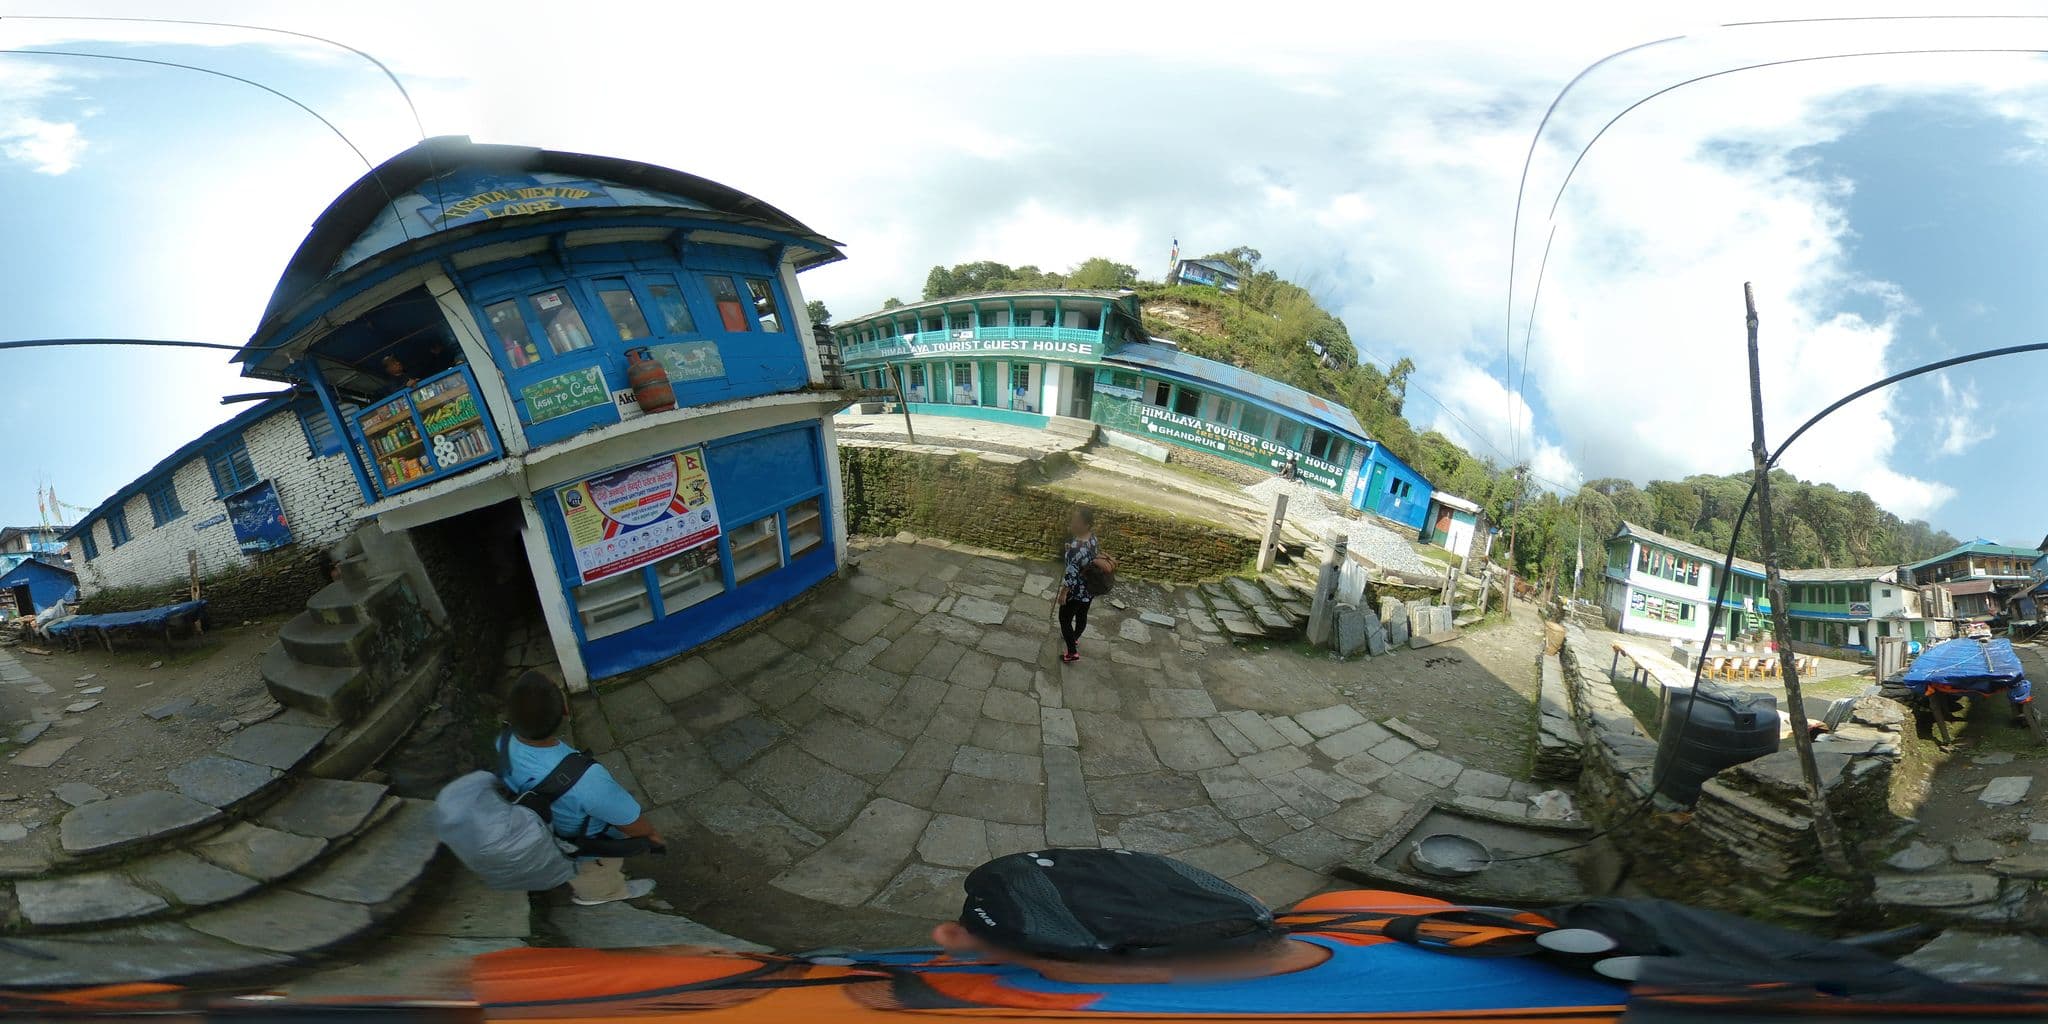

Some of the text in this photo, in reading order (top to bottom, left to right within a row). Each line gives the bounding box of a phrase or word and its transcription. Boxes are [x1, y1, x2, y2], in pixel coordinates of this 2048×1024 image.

[881, 340, 1092, 357] HIMALAYA TOURIST GUEST HOUSE
[570, 381, 600, 398] CASH
[1141, 406, 1344, 476] HIMALAYA TOURIST GUEST HOUSE
[1158, 426, 1217, 449] GHANDRUK
